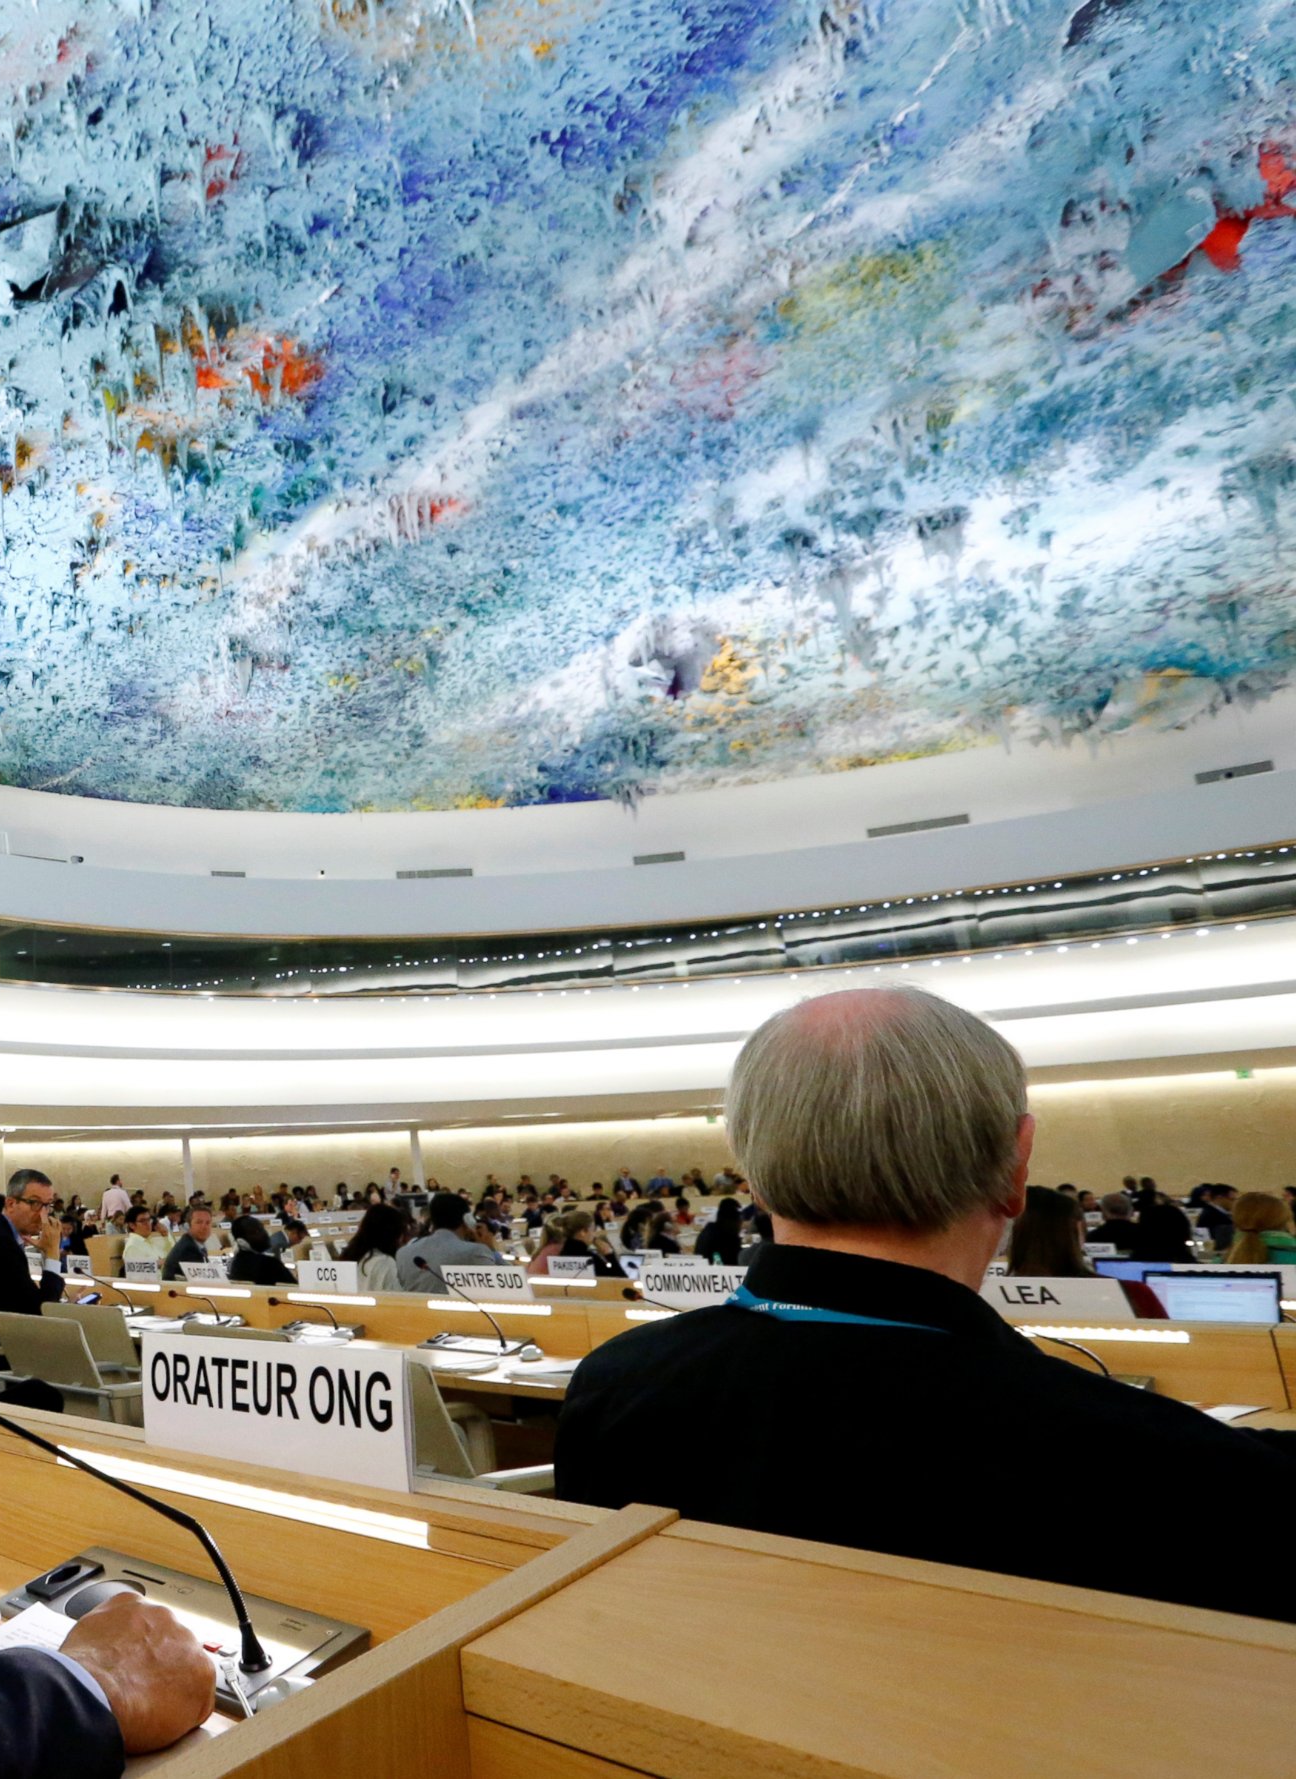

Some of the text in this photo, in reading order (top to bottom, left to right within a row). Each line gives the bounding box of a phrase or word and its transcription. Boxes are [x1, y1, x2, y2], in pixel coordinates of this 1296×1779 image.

[316, 1267, 338, 1281] CCG
[445, 1272, 524, 1289] CENTRE SUD
[645, 1274, 744, 1293] COMMONWEALT
[999, 1285, 1062, 1305] LEA
[150, 1351, 394, 1432] ORATEUR ONG
